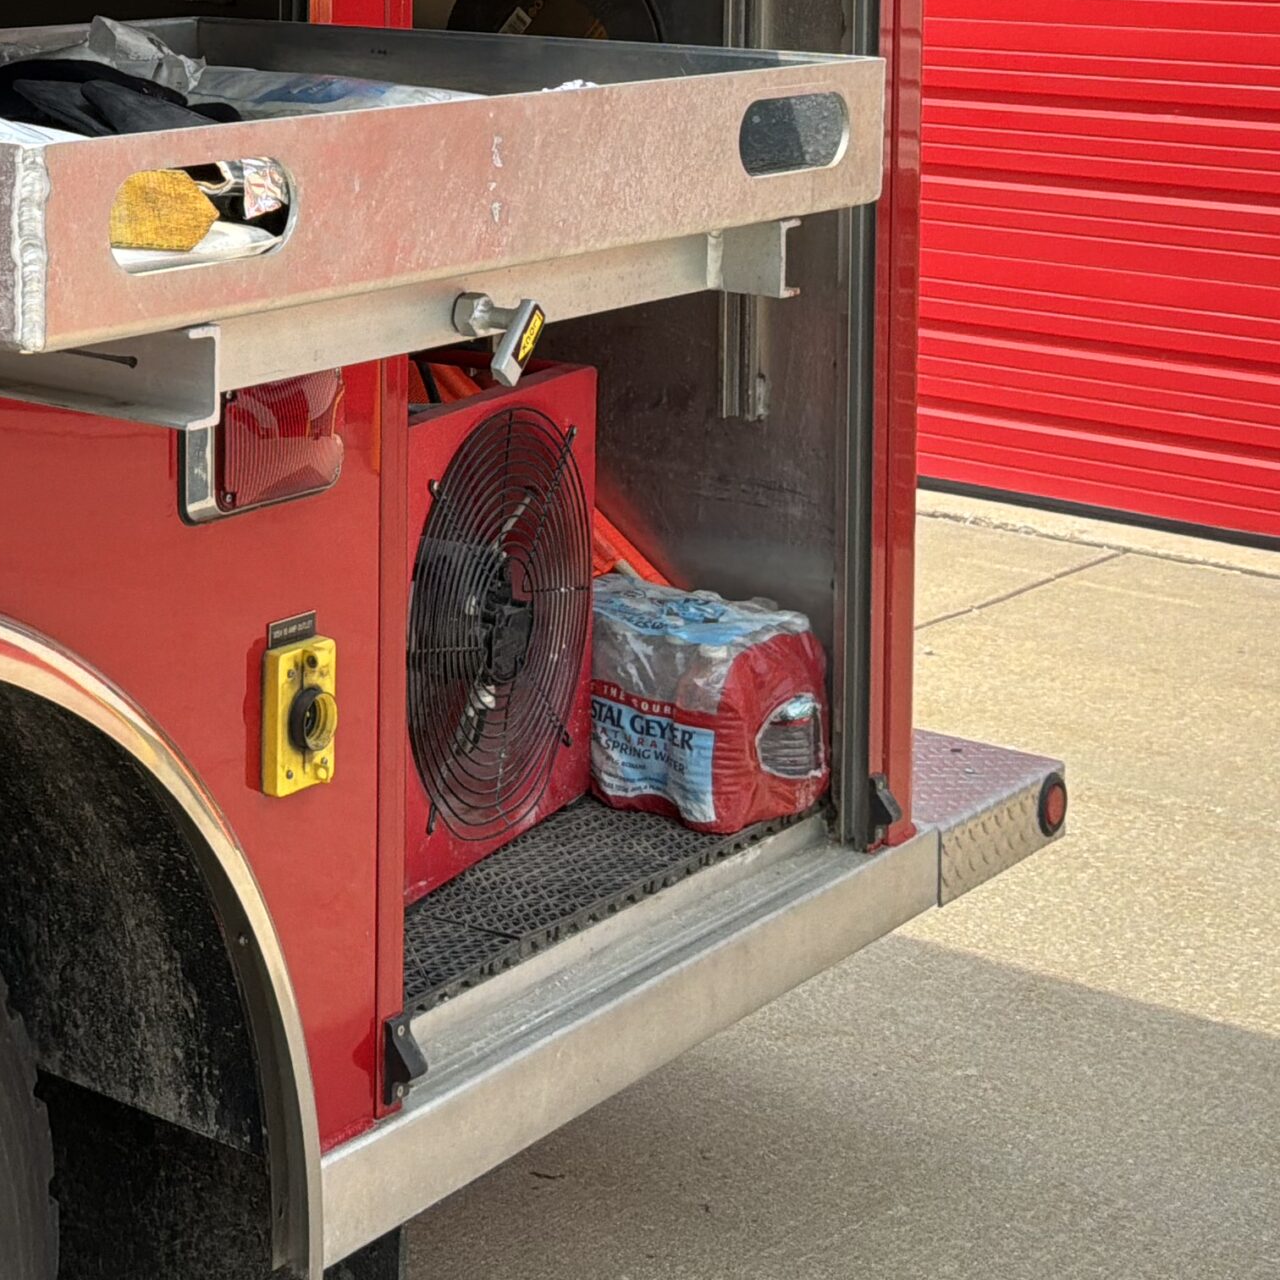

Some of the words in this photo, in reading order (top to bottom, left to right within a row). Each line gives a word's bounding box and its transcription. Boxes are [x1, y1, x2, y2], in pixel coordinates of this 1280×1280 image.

[603, 685, 625, 701] THE
[631, 698, 672, 714] SOUR
[591, 699, 625, 730] STAL
[630, 714, 694, 751] GEYER
[605, 738, 651, 760] SPRING
